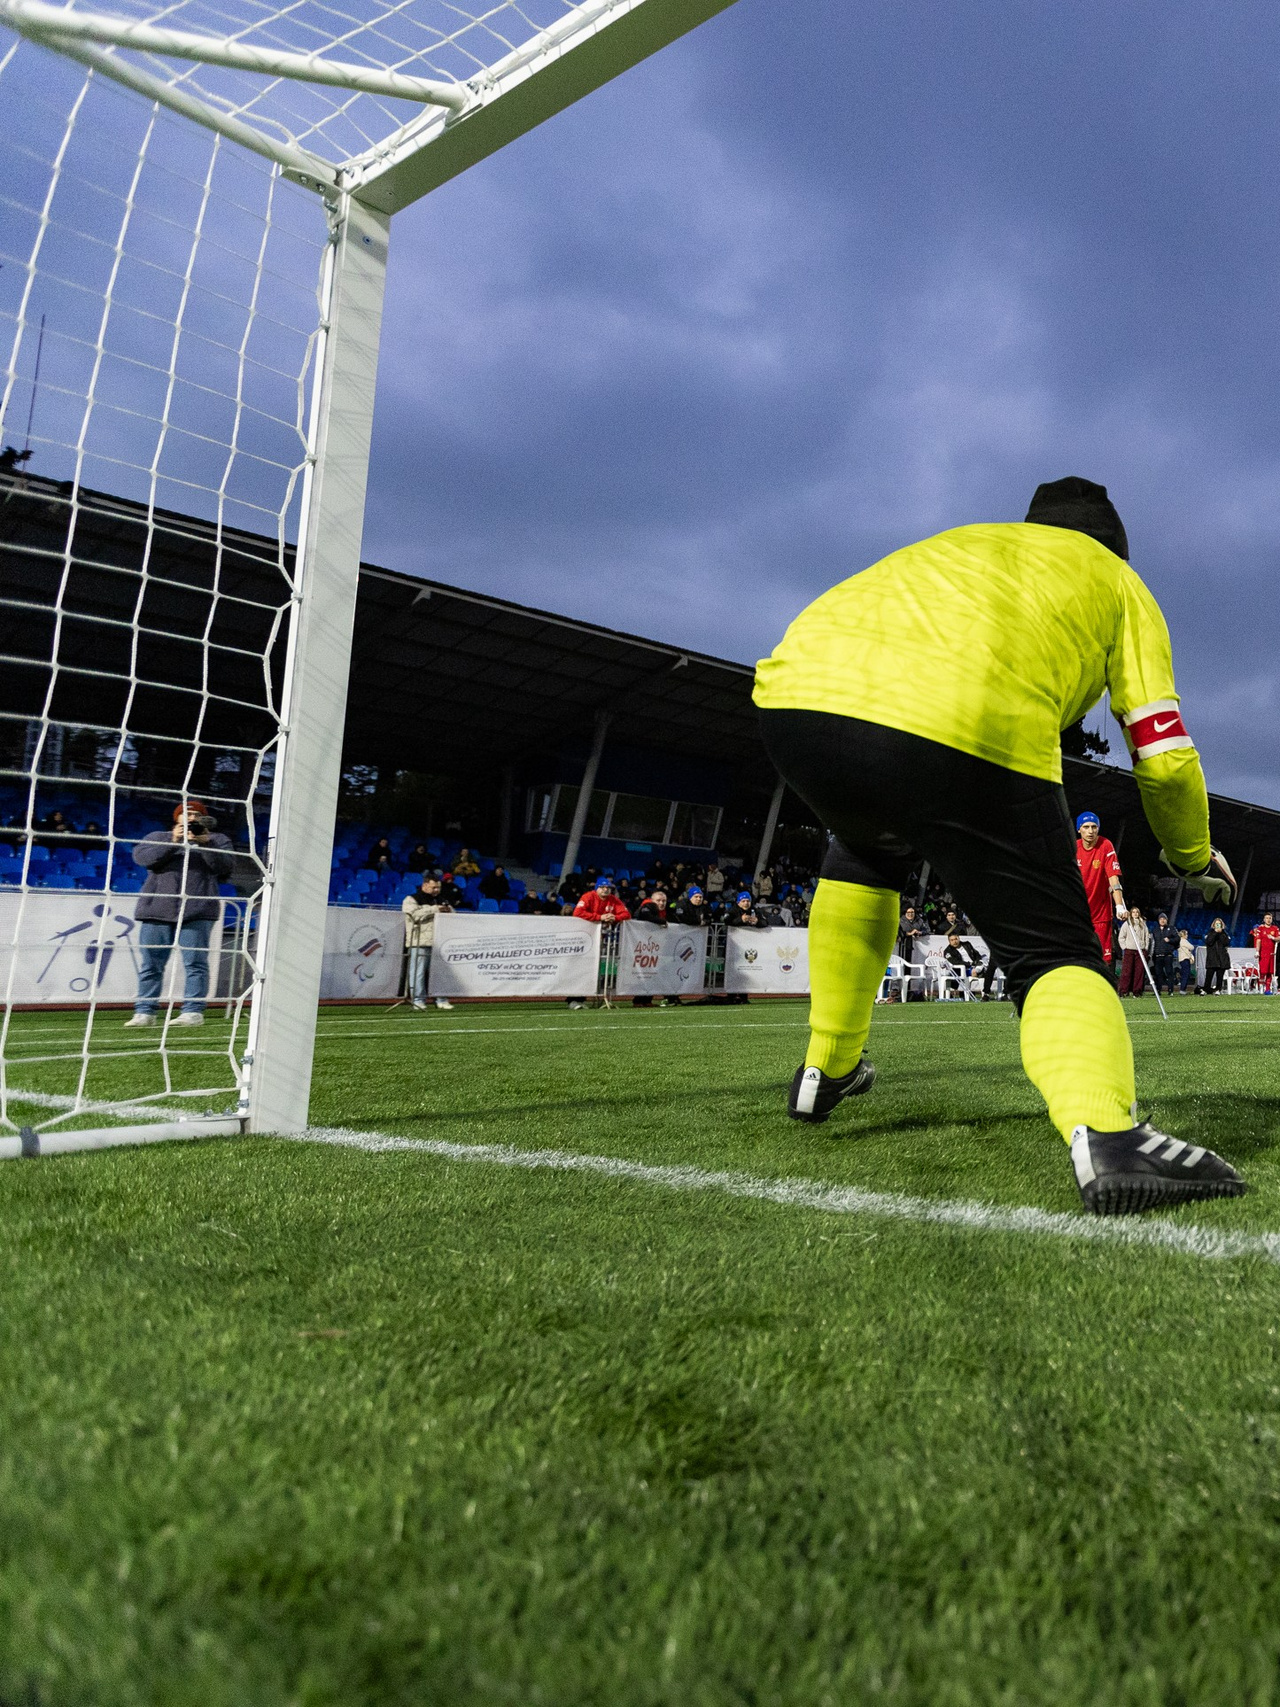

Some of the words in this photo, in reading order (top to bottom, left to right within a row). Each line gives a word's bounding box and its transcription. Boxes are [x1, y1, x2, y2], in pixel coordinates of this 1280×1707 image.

[447, 952, 484, 961] ГЕРОИ
[485, 948, 533, 959] НАШЕГО
[534, 945, 585, 956] ВРЕМЕНИ
[633, 955, 659, 968] FON
